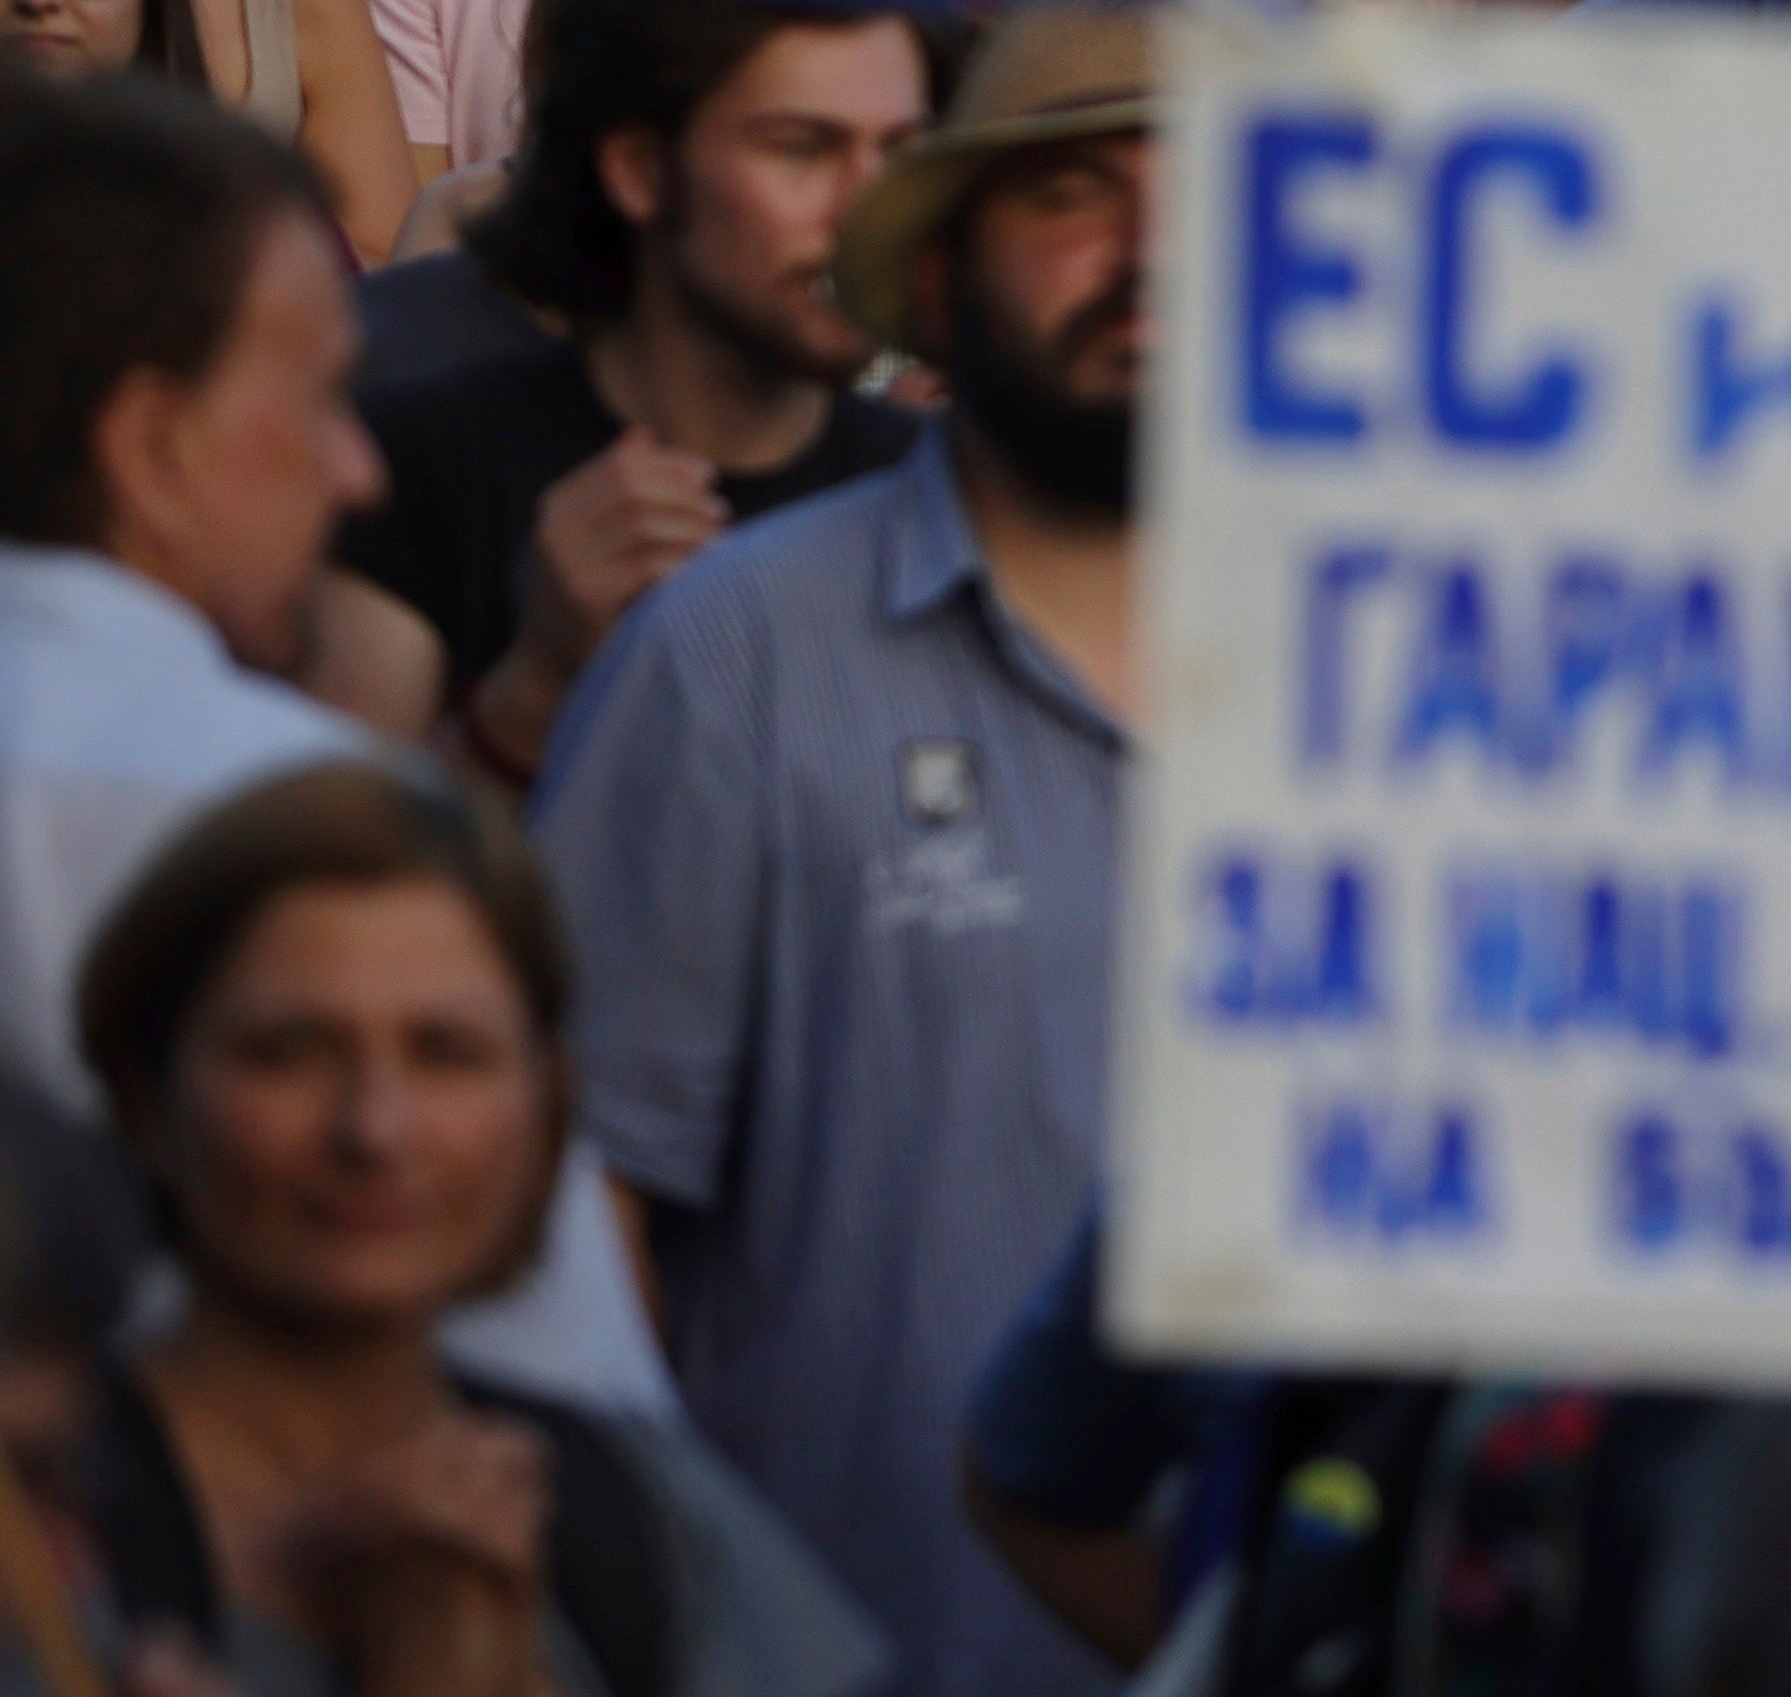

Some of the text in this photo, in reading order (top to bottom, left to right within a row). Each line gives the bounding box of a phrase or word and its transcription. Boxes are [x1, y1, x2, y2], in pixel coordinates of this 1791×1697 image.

[1238, 111, 1606, 453] ЕС
[1196, 853, 1380, 1028] ЗА
[1300, 1098, 1485, 1238] НА
